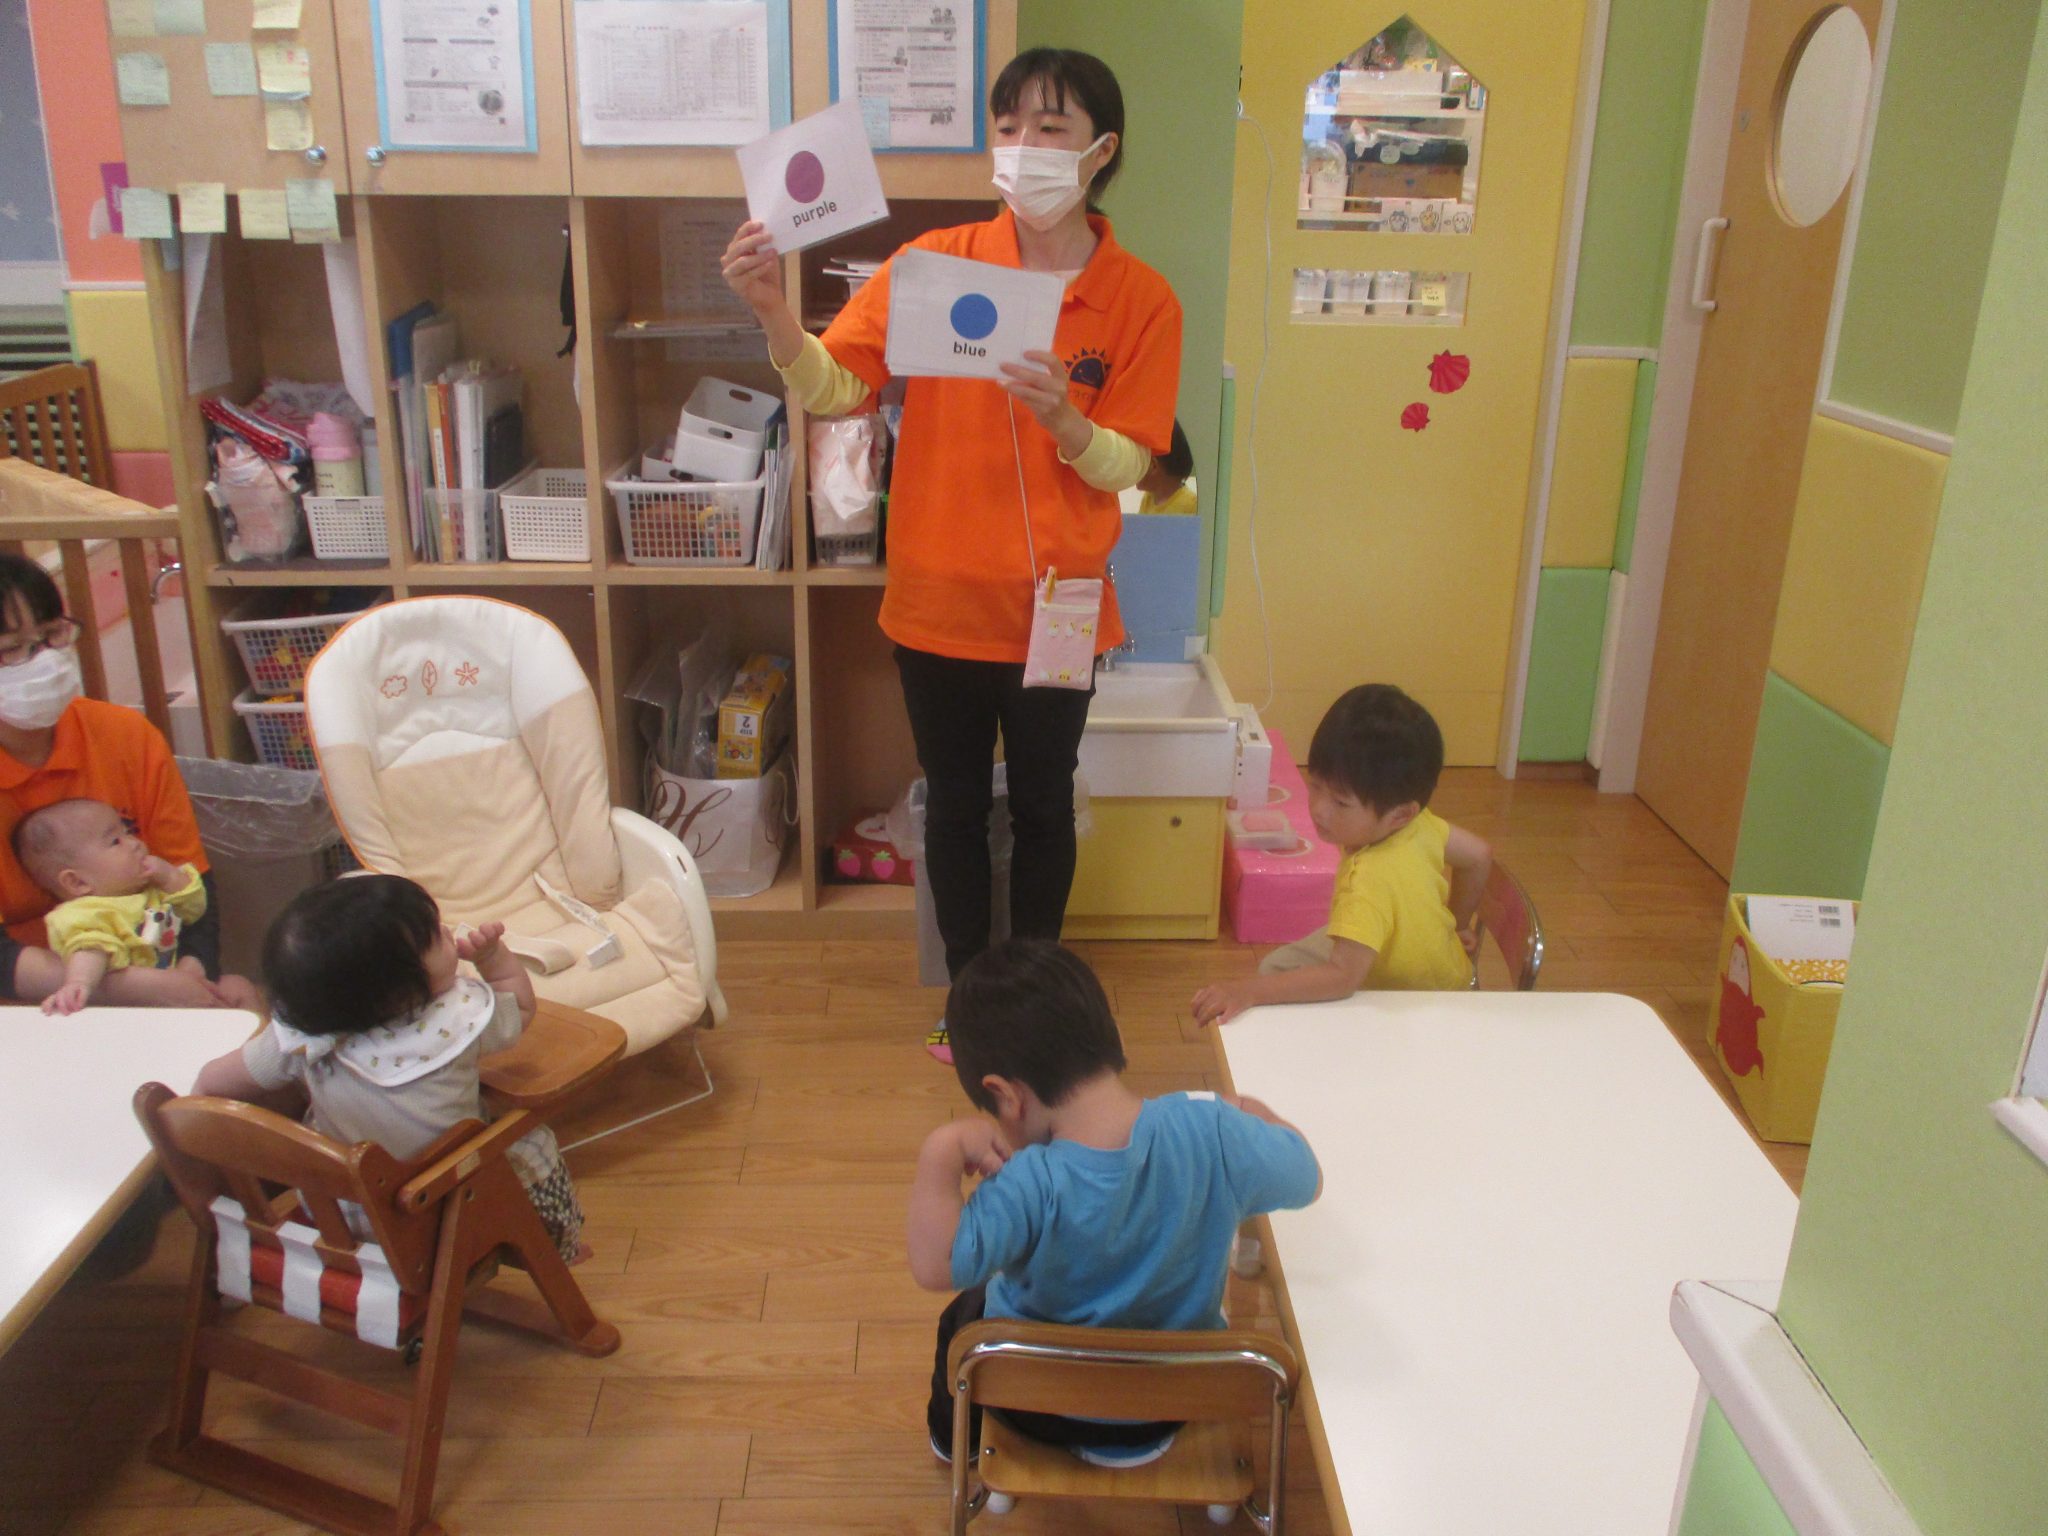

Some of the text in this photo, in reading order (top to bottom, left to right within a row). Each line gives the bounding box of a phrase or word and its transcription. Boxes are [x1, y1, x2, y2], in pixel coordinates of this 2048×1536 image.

[792, 201, 838, 228] purple
[953, 341, 987, 357] blue
[742, 715, 751, 728] 2
